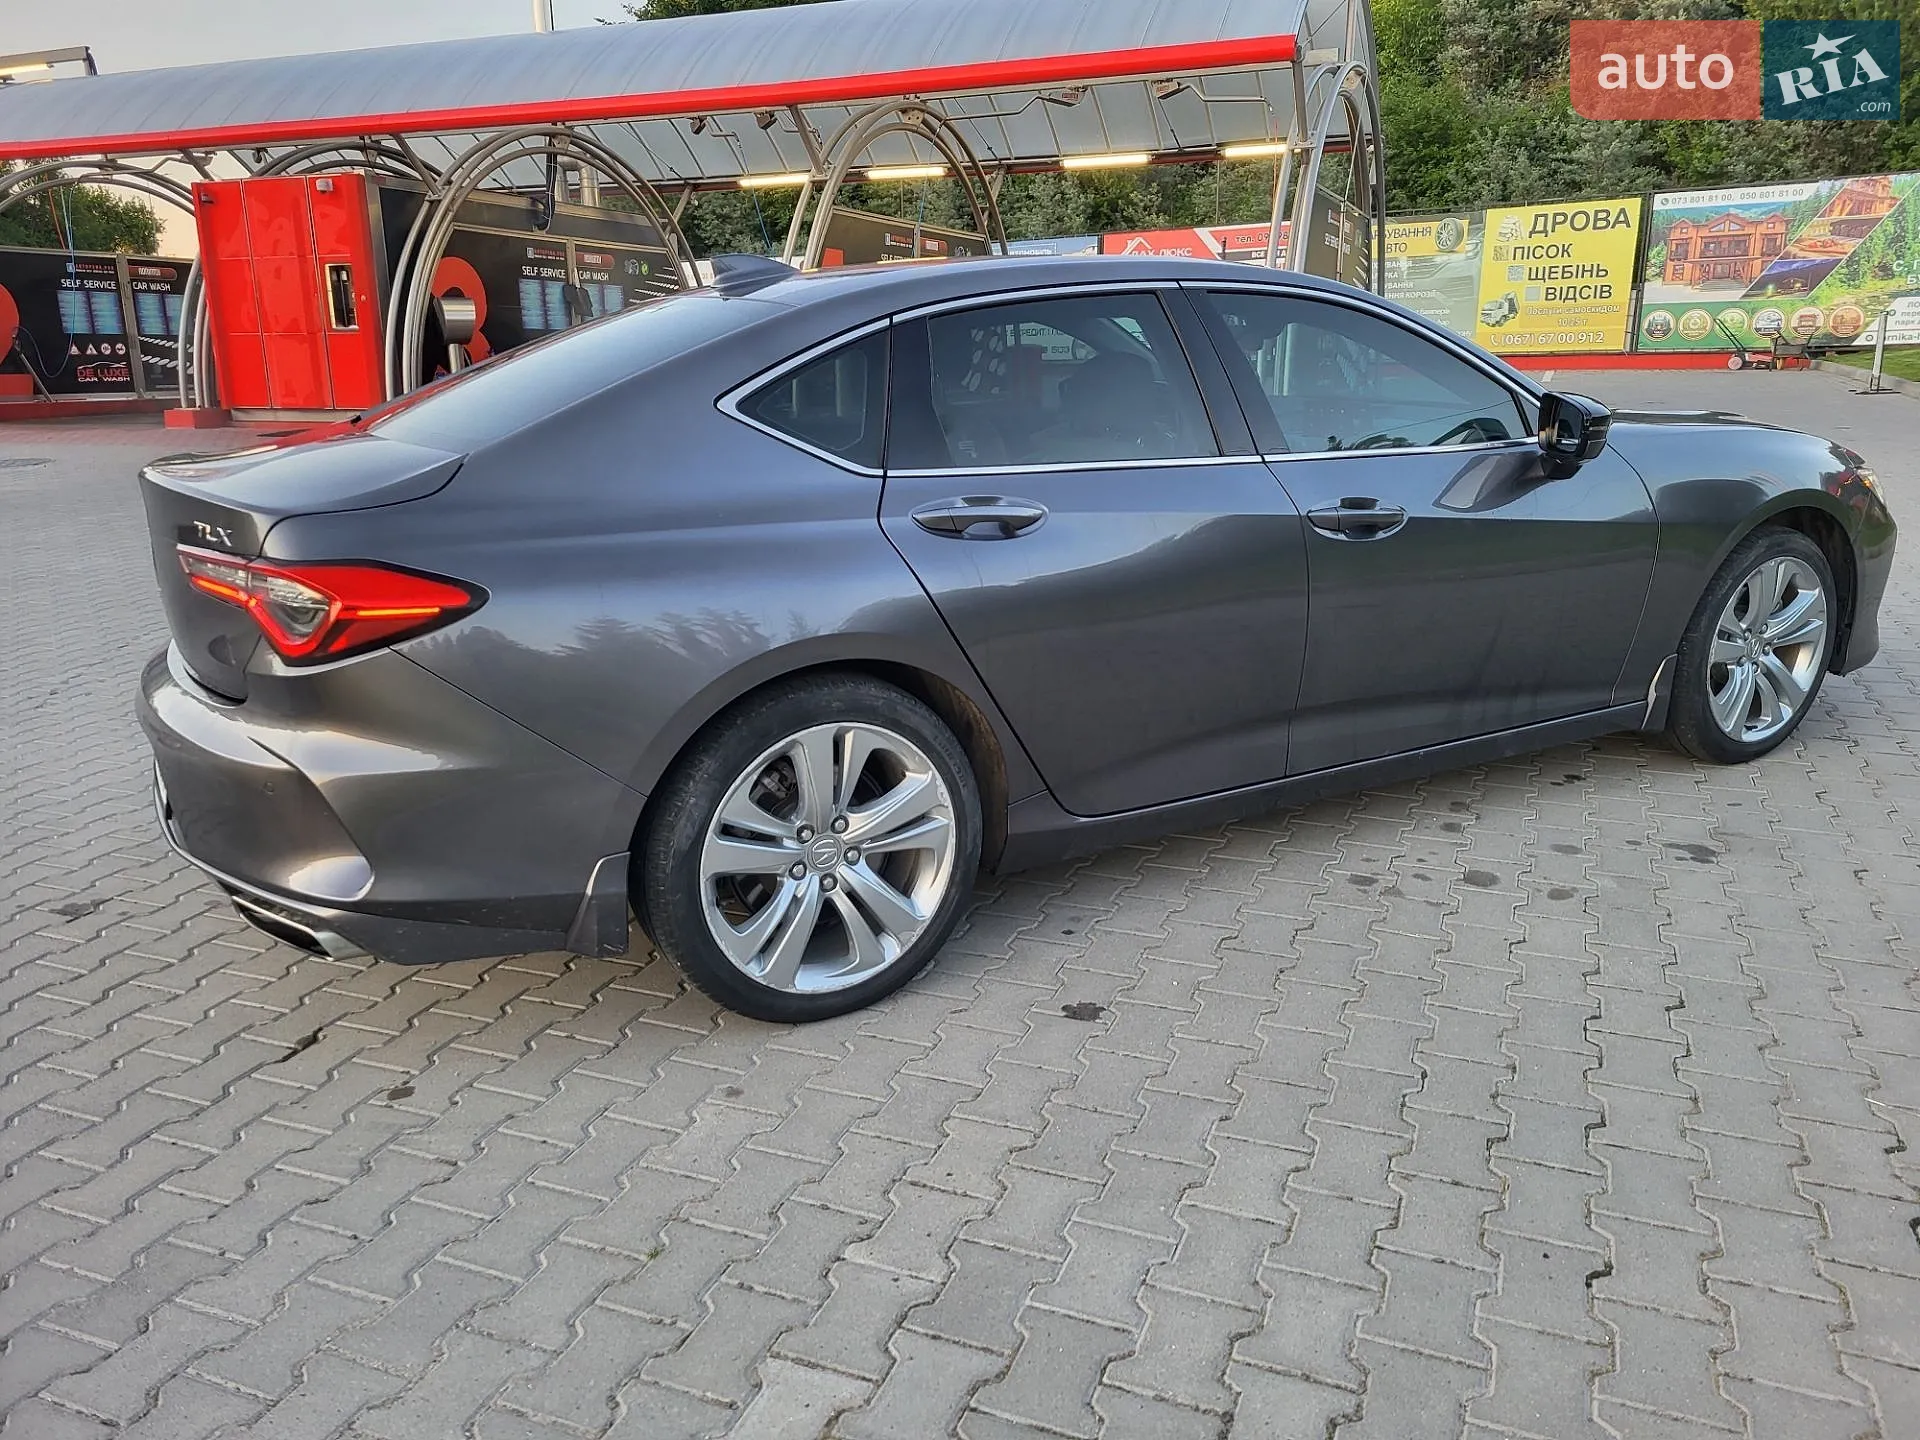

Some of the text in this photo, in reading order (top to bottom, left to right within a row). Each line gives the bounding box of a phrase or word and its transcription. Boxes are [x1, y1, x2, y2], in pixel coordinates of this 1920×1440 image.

[1528, 207, 1631, 238] ДРОВА
[1512, 243, 1573, 261] ПІСОК
[521, 265, 609, 281] SELF SERVICE CAR WASH
[1528, 263, 1609, 283] ЩЕБІНЬ
[60, 279, 171, 291] SELF SERVICE CAR WASH
[1544, 284, 1613, 304] ВІДСІВ
[1501, 331, 1604, 346] (067) 67 00 912
[77, 367, 129, 377] DE LUXE
[193, 520, 233, 547] TLX
